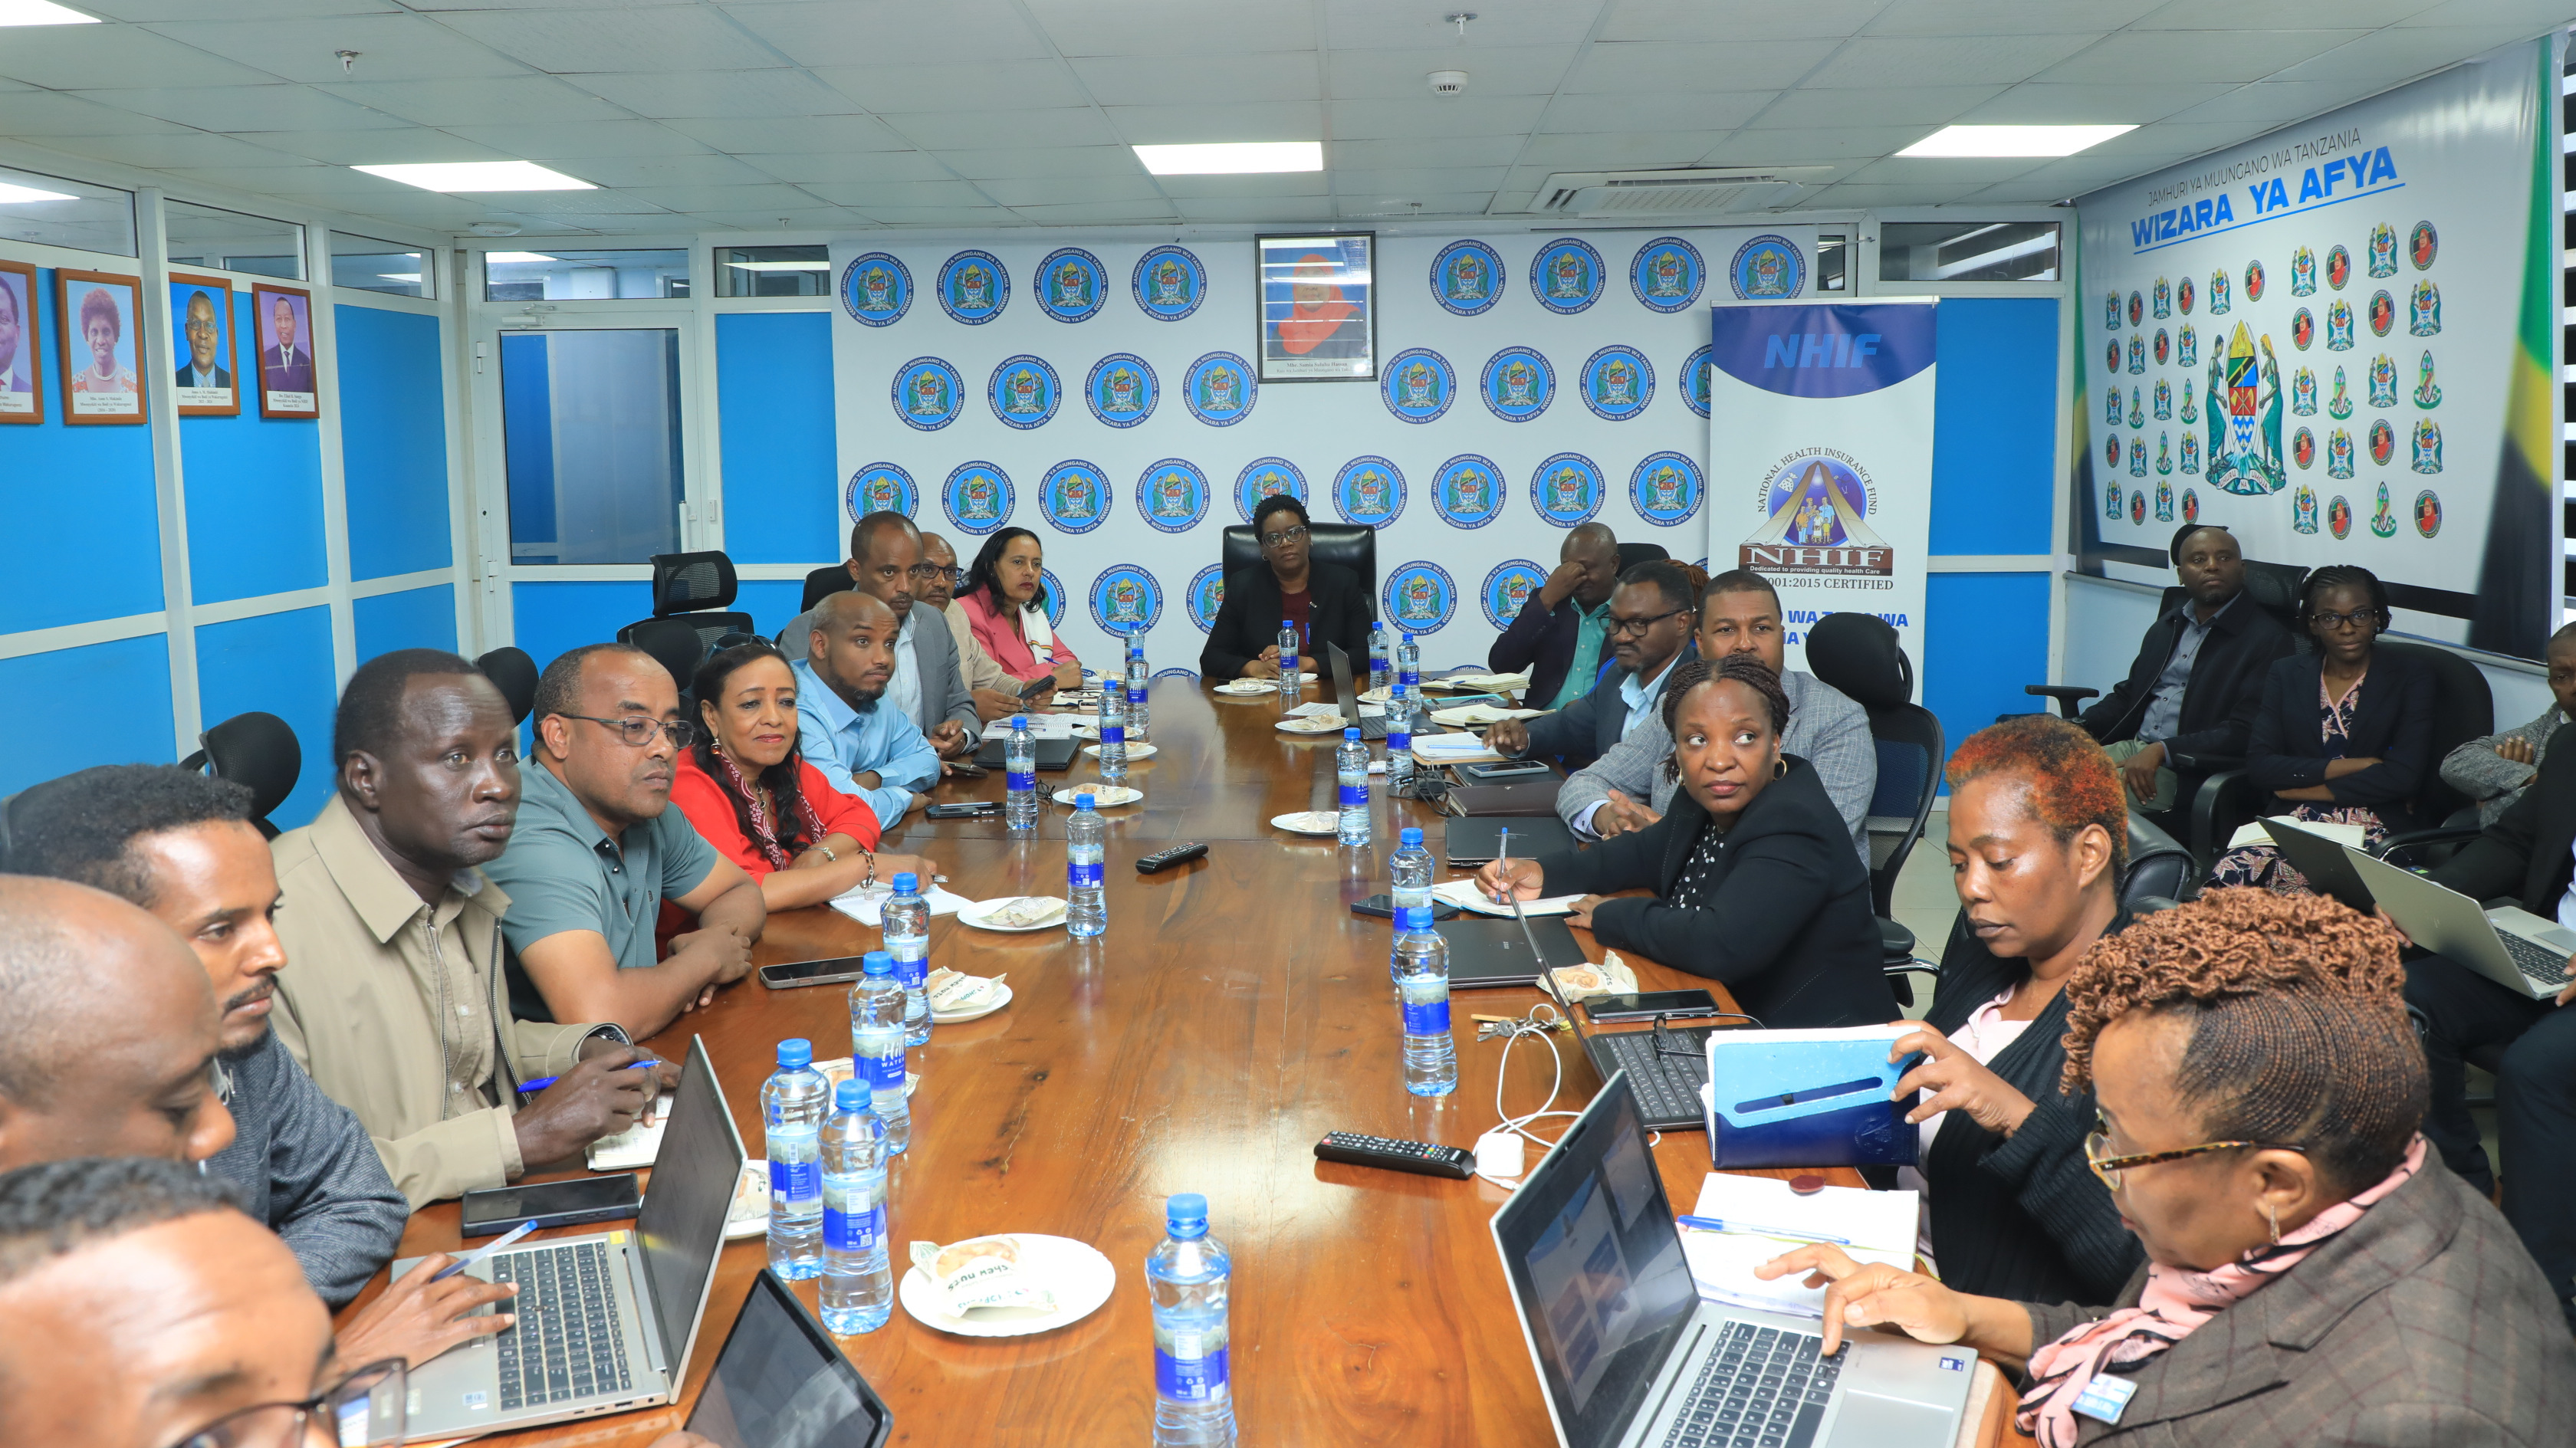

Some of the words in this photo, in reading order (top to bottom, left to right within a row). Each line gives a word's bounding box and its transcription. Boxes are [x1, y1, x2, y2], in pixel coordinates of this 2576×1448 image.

[2148, 181, 2189, 207] JAMHURI
[2190, 176, 2203, 192] YA
[2204, 156, 2269, 190] MUUNGANO
[2272, 149, 2292, 169] WA
[2295, 127, 2361, 163] TANZANIA
[2131, 193, 2234, 248] WIZARA
[2249, 178, 2289, 215] YA
[2298, 146, 2397, 204] AFYA
[1631, 253, 1642, 276] JAMHURI
[1649, 238, 1681, 248] MUUNGANO
[1682, 241, 1691, 250] WA
[1691, 248, 1704, 275] TANZANIA
[1731, 251, 1743, 274] JAMHURI
[1749, 236, 1781, 246] MUUNGANO
[1782, 239, 1791, 248] WA
[1791, 247, 1804, 274] TANZANIA
[1036, 264, 1046, 287] JAMHURI
[1052, 249, 1083, 258] MUUNGANO
[1084, 252, 1092, 261] WA
[1093, 259, 1106, 285] TANZANIA
[1134, 261, 1144, 284] JAMHURI
[1150, 247, 1181, 256] MUUNGANO
[1182, 250, 1191, 259] WA
[1191, 257, 1205, 284] TANZANIA
[1148, 309, 1168, 320] WIZARA
[1178, 310, 1192, 319] AFYA
[1645, 299, 1665, 311] WIZARA
[1676, 301, 1690, 310] AFYA
[1050, 311, 1070, 322] WIZARA
[1080, 311, 1093, 320] AFYA
[1763, 333, 1882, 369] NHIF
[989, 370, 1000, 393] JAMHURI
[1006, 356, 1037, 365] MUUNGANO
[1038, 360, 1046, 368] WA
[1046, 366, 1060, 392] TANZANIA
[1087, 369, 1097, 392] JAMHURI
[1103, 354, 1135, 363] MUUNGANO
[1135, 357, 1144, 366] WA
[1144, 364, 1158, 391] TANZANIA
[1582, 360, 1592, 384] JAMHURI
[1598, 346, 1630, 356] MUUNGANO
[1631, 350, 1640, 358] WA
[1641, 356, 1654, 383] TANZANIA
[893, 372, 903, 395] JAMHURI
[909, 358, 940, 366] MUUNGANO
[941, 361, 949, 369] WA
[949, 368, 963, 394] TANZANIA
[907, 419, 927, 429] WIZARA
[937, 419, 951, 428] AFYA
[1004, 418, 1024, 428] WIZARA
[1033, 418, 1047, 426] AFYA
[1101, 415, 1121, 427] WIZARA
[1132, 416, 1145, 425] AFYA
[1595, 409, 1615, 419] WIZARA
[1626, 409, 1640, 419] AFYA
[1040, 474, 1050, 497] JAMHURI
[1056, 461, 1087, 470] MUUNGANO
[1097, 471, 1111, 497] TANZANIA
[1138, 474, 1148, 497] JAMHURI
[1154, 460, 1185, 468] MUUNGANO
[1195, 469, 1208, 496] TANZANIA
[1631, 467, 1642, 490] JAMHURI
[1648, 452, 1680, 461] MUUNGANO
[1681, 455, 1689, 464] WA
[1690, 463, 1702, 489] TANZANIA
[1758, 465, 1783, 513] NATIONAL
[1780, 447, 1822, 466] HEALTH
[1824, 448, 1872, 487] INSURANCE
[1867, 487, 1878, 515] FUND
[2220, 471, 2236, 487] UHURU
[2251, 472, 2268, 489] UMOJA
[1054, 522, 1075, 533] WIZARA
[1084, 522, 1098, 532] AFYA
[1152, 521, 1171, 531] WIZARA
[1182, 521, 1195, 530] AFYA
[1644, 514, 1664, 525] WIZARA
[1674, 515, 1688, 524] AFYA
[1746, 547, 1884, 567] NHIF
[1384, 576, 1395, 599] JAMHURI
[1401, 562, 1432, 571] MUUNGANO
[1442, 572, 1455, 598] TANZANIA
[1768, 577, 1821, 588] 001:2015
[1824, 578, 1894, 590] CERTIFIED
[1788, 610, 1818, 624] WA
[1398, 623, 1418, 634] WIZARA
[1428, 624, 1442, 633] AFYA
[1157, 669, 1189, 678] MUUNGANO
[1129, 682, 1142, 691] Hill
[882, 1036, 905, 1062] Hill
[980, 1265, 1010, 1276] shew
[948, 1272, 976, 1292] nuts
